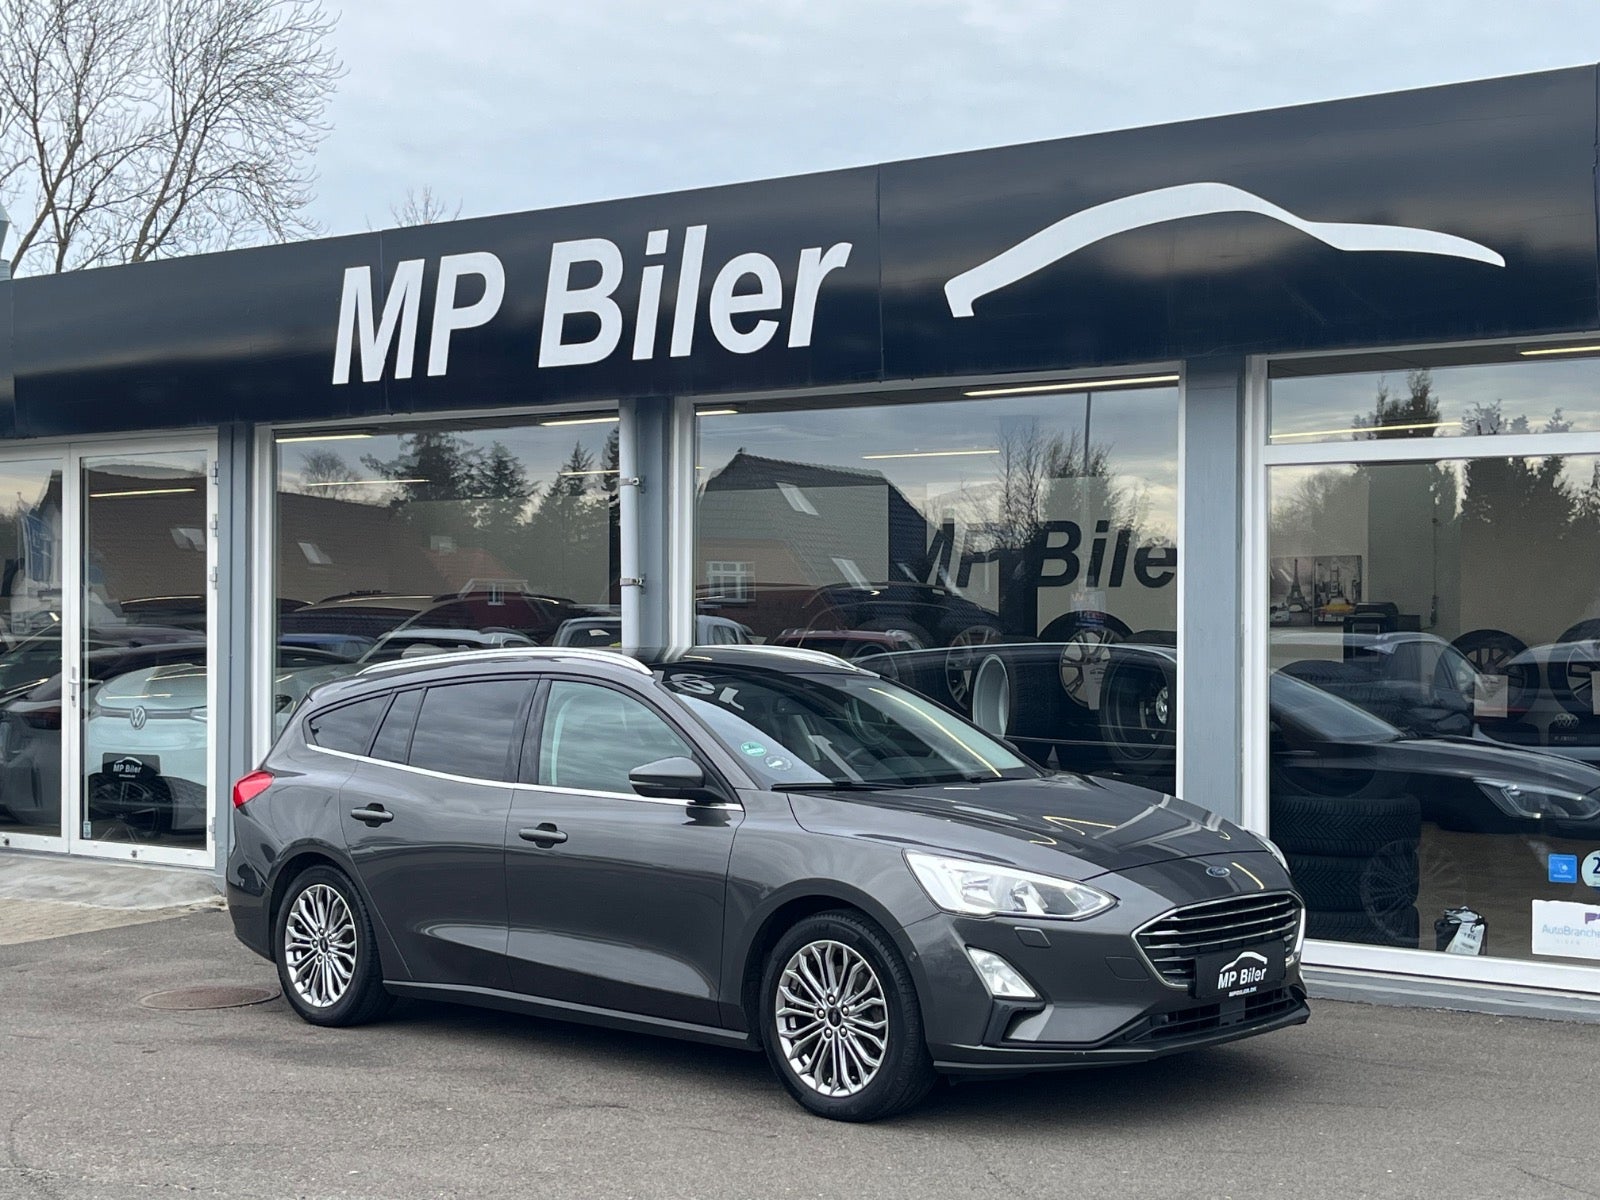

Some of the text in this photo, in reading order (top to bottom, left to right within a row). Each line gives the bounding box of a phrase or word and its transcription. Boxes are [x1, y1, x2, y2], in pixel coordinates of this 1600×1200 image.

[332, 224, 853, 385] MP Biler
[113, 764, 124, 773] MP
[1218, 967, 1267, 990] MP Biler
